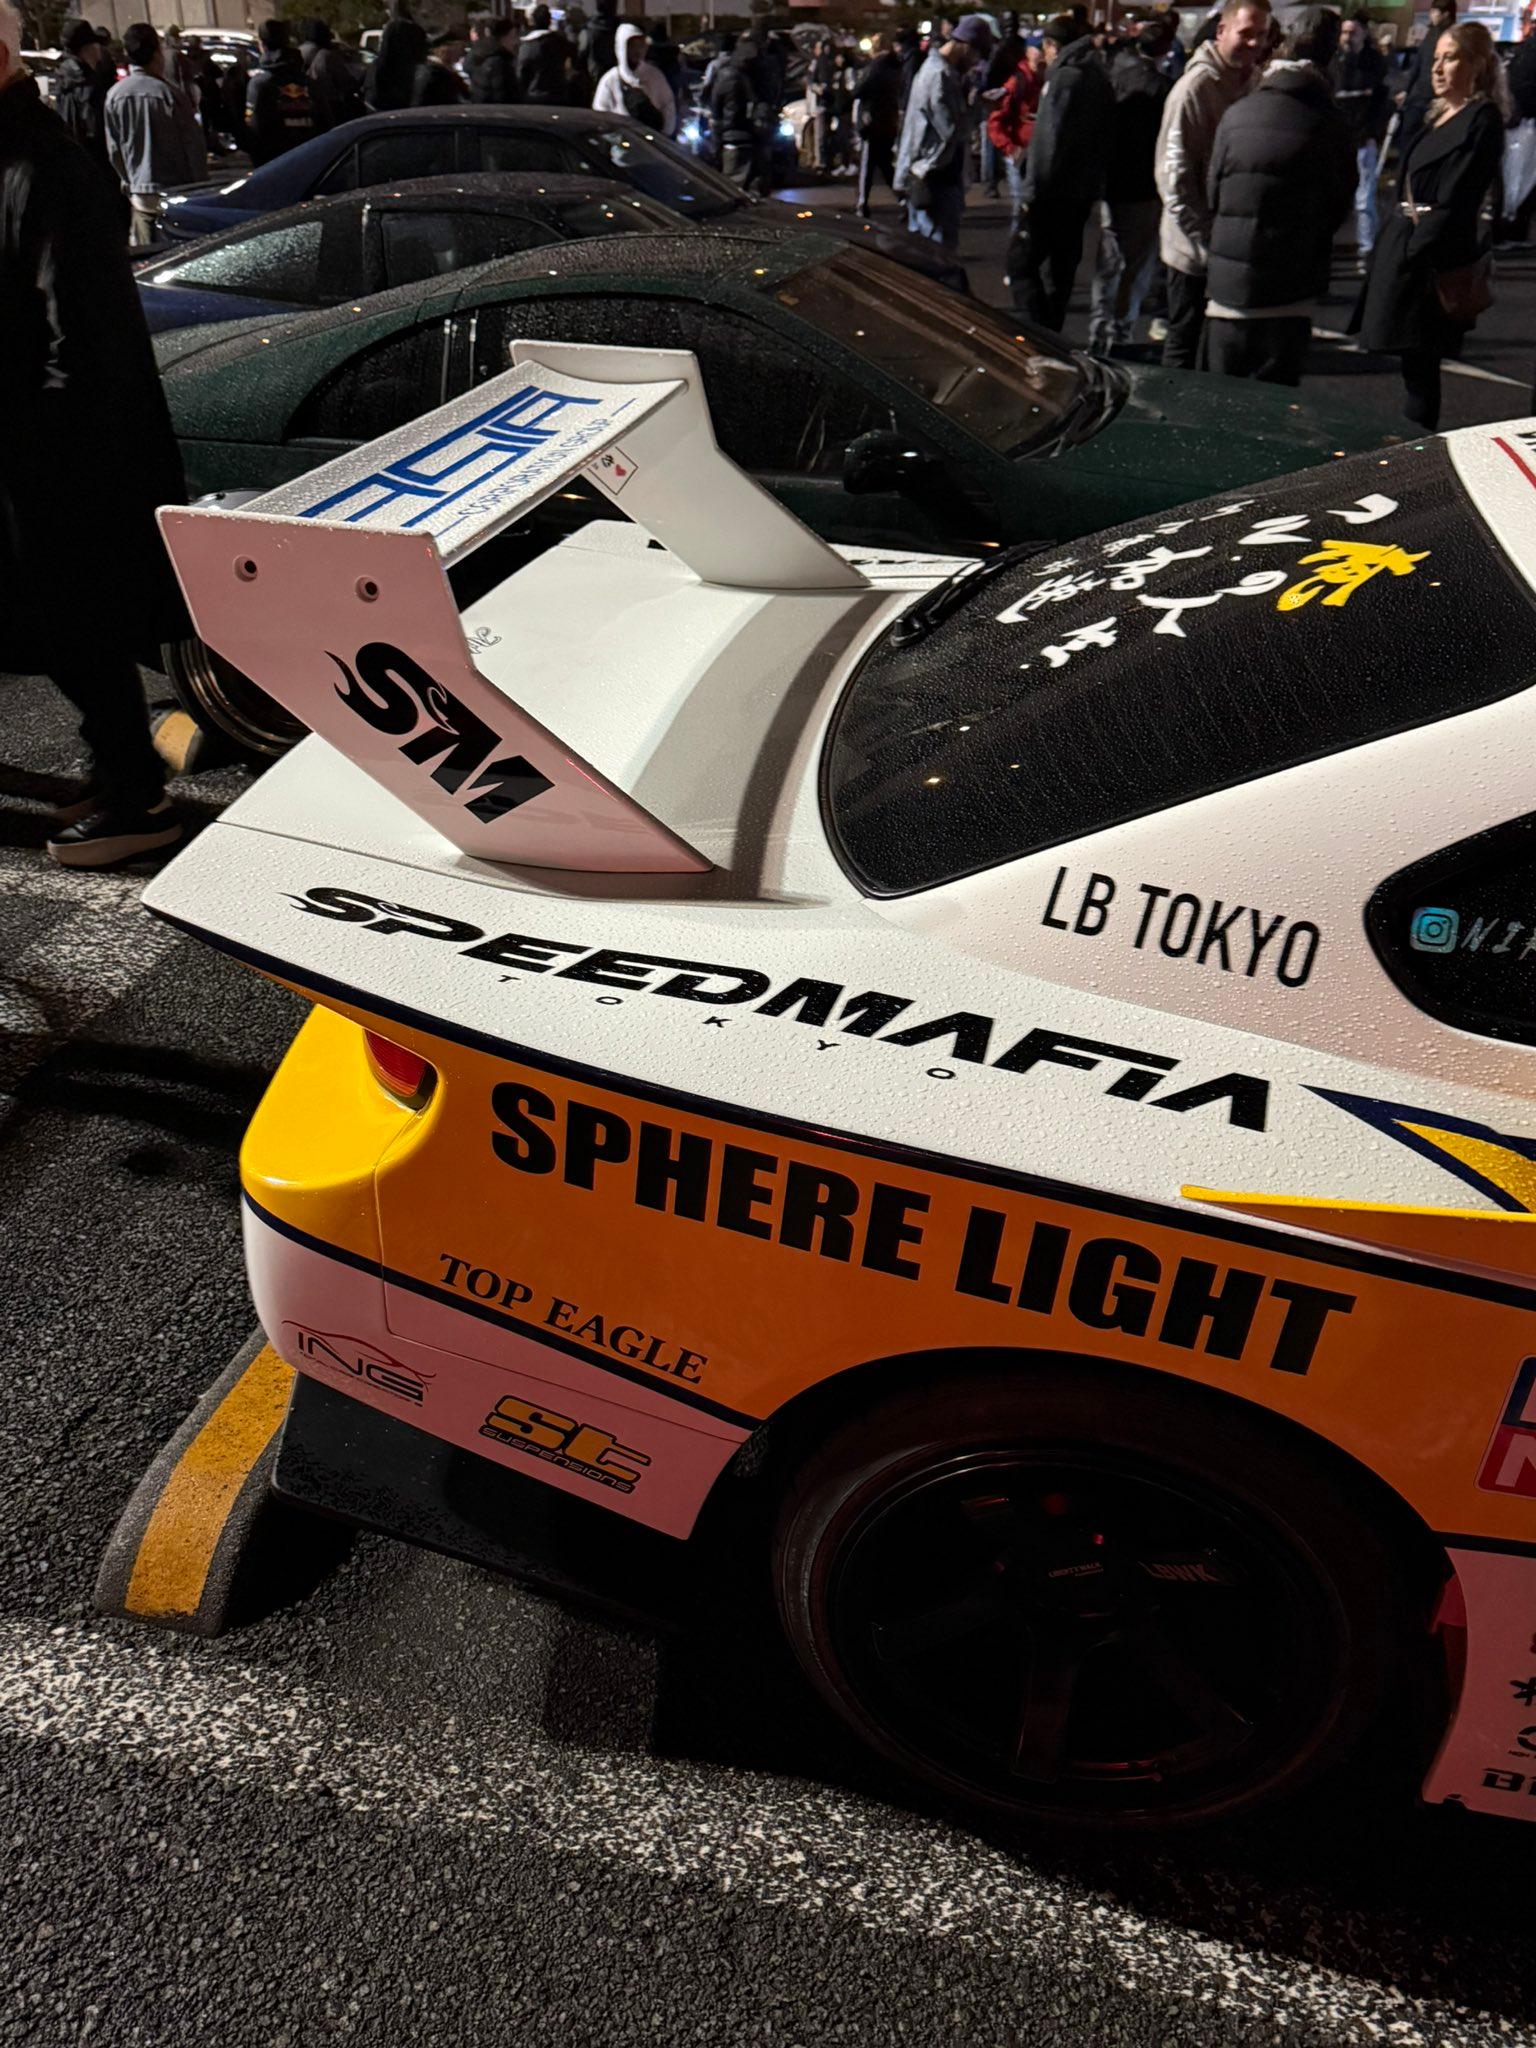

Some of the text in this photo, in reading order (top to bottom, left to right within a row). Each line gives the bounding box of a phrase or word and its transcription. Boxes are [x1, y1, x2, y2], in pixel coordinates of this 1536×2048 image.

[1041, 865, 1321, 988] LB TOKYO
[280, 886, 1270, 1133] SPEEDMAFIA
[498, 974, 957, 1081] TOKYO
[490, 1081, 1357, 1377] SPHERE LIGHT
[439, 1253, 708, 1384] TOP EAGLE
